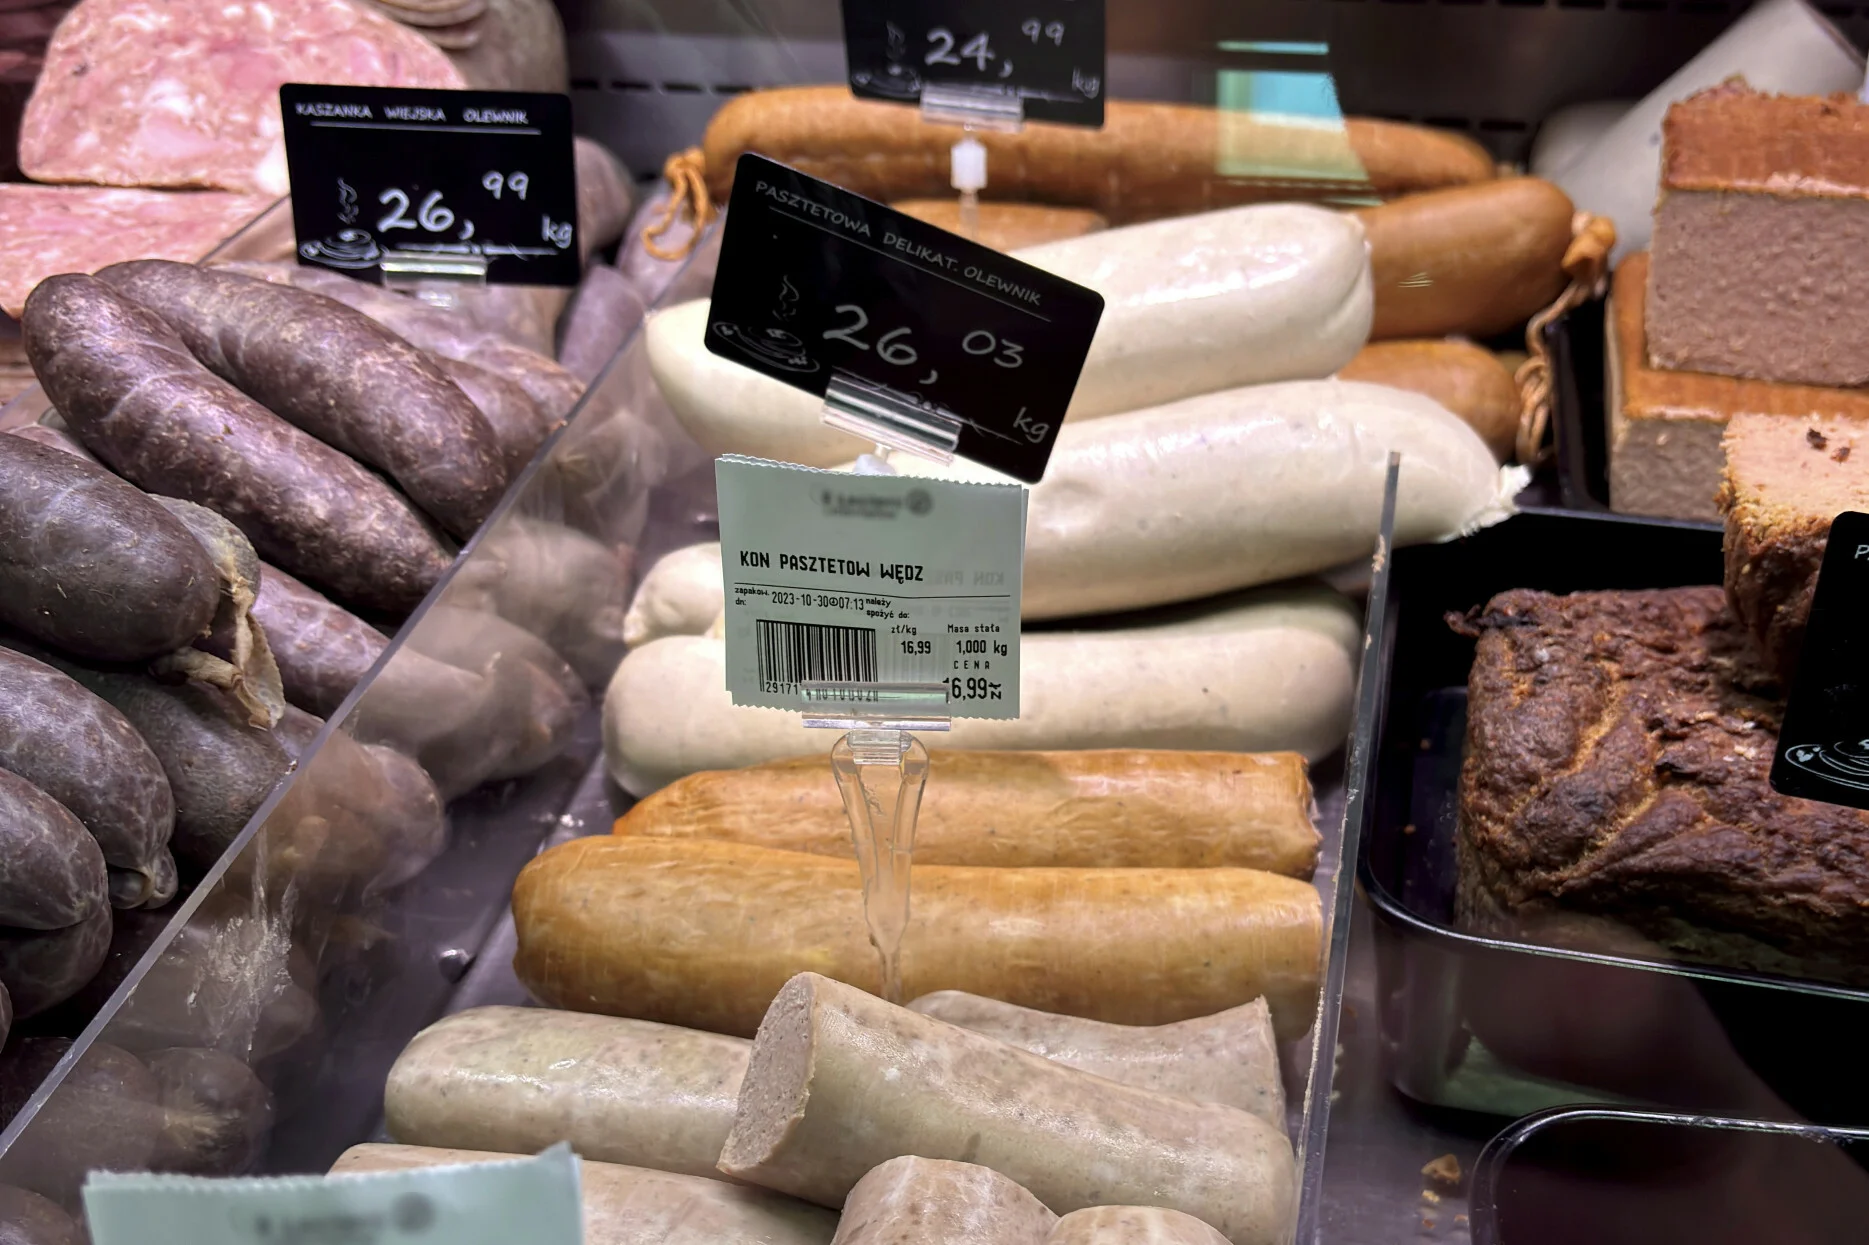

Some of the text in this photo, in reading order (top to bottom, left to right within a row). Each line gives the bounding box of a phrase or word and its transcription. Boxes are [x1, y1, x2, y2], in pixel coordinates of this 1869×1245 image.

[923, 26, 1014, 78] 24,
[1021, 17, 1065, 47] 99
[295, 102, 529, 124] KASZANKA WIEJSKA OLEWNIK
[376, 170, 573, 249] 26, 99 kg
[755, 181, 1042, 306] PASZTETOWA DELIKAT. OLEWNIK
[822, 304, 1050, 444] 26, 03 kg
[1853, 544, 1869, 561] P
[740, 550, 924, 584] KON PASZTETOW WĘDZ
[734, 586, 770, 596] zapakow.
[735, 596, 747, 606] dn:
[898, 610, 910, 620] do:
[891, 624, 917, 636] zł/kg
[947, 623, 1000, 634] Masa stała
[900, 640, 932, 656] 16,99
[956, 639, 1008, 657] 1,000 kg
